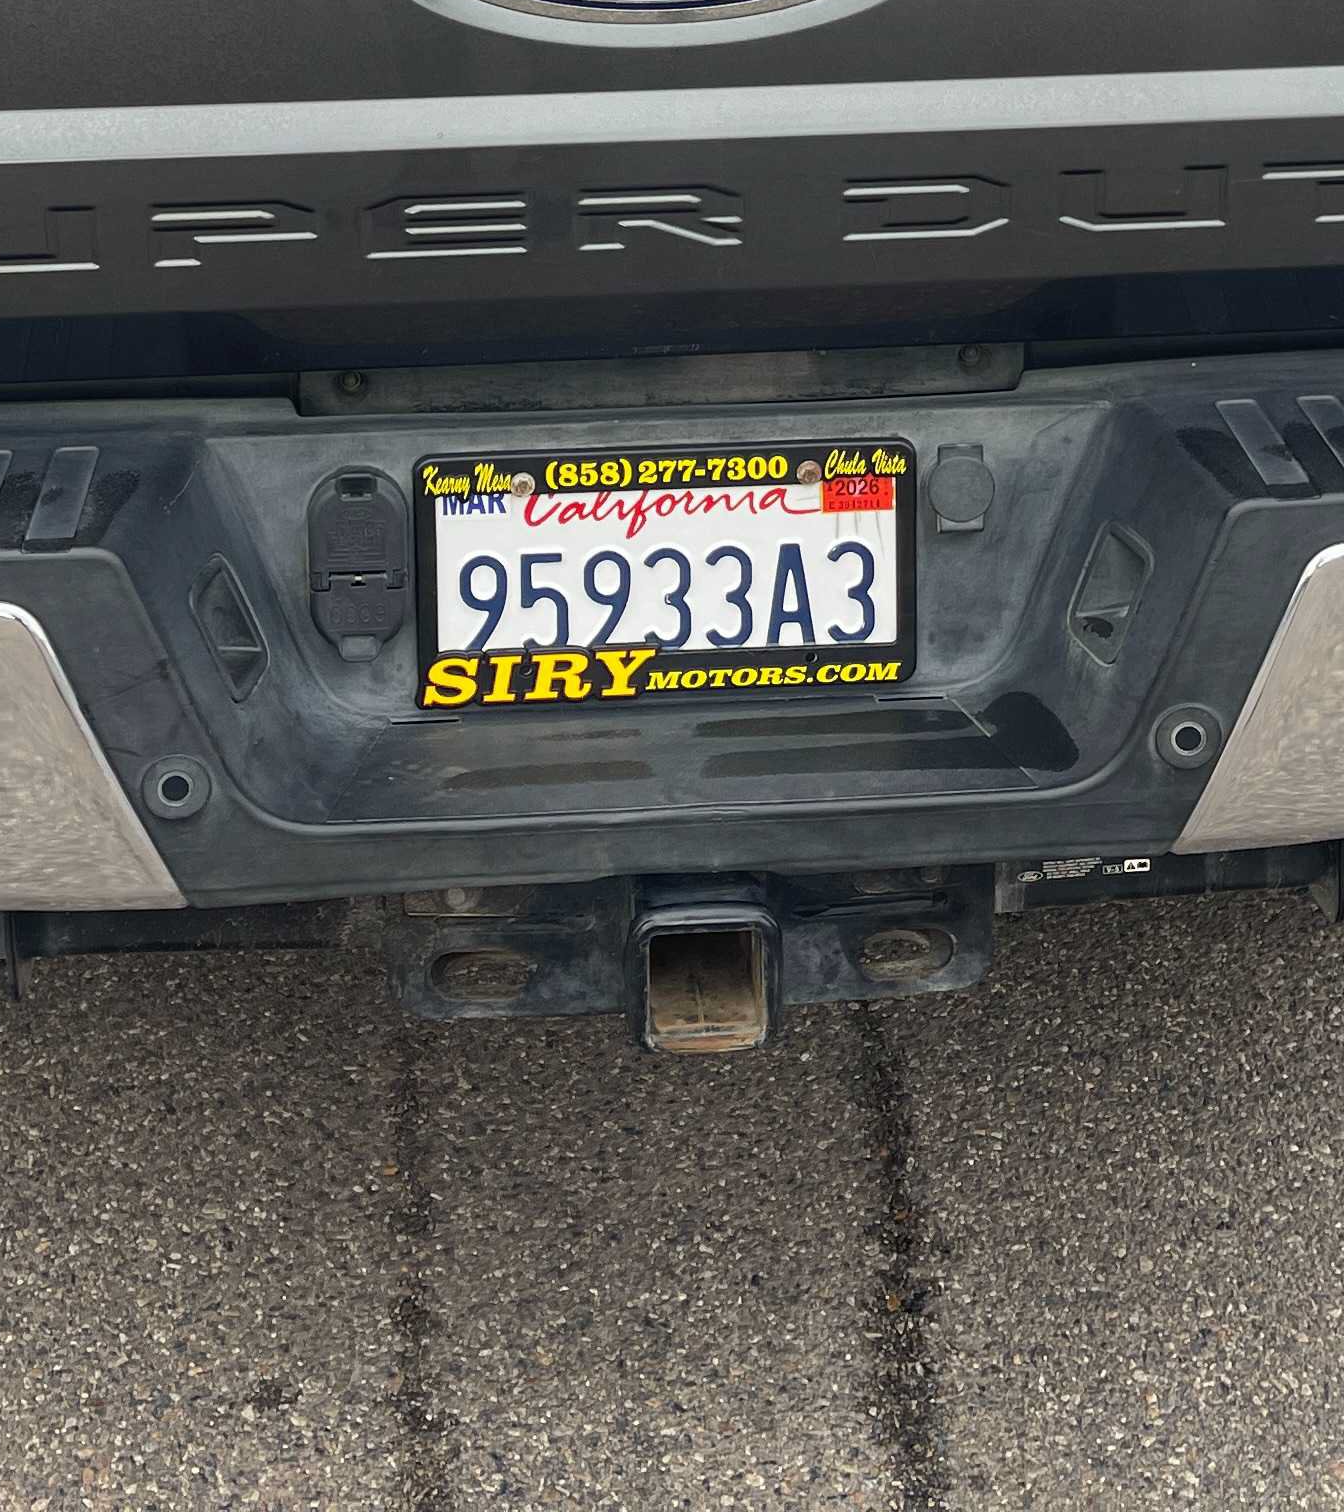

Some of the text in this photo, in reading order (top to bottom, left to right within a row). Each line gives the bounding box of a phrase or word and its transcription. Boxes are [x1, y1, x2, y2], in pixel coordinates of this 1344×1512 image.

[422, 449, 908, 497] Kearny Mesa (858) 277-7300 Chula Vista
[441, 479, 880, 540] MAR California 2026
[459, 541, 876, 651] 95933A3
[422, 648, 902, 707] SIRY MOTORS.COM
